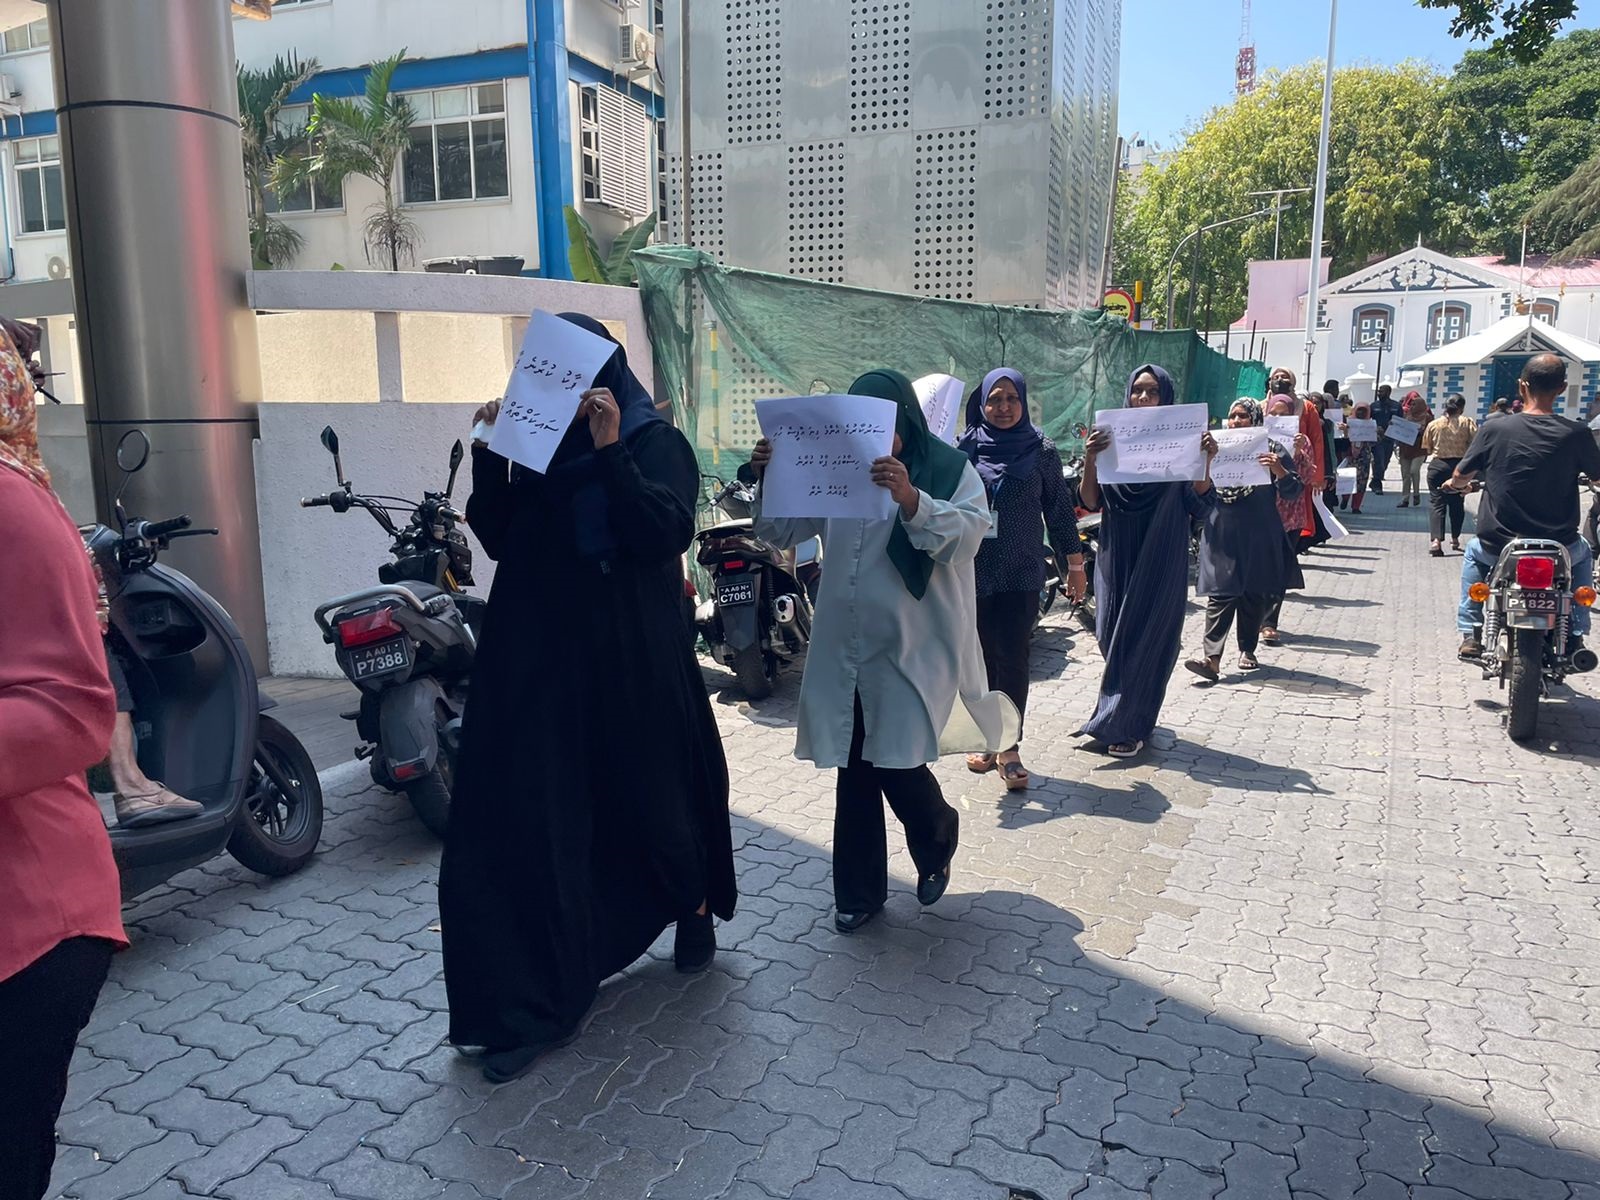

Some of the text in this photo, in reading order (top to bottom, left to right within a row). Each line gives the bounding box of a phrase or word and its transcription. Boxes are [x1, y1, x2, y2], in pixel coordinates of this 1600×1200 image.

[720, 591, 752, 603] C7061
[1509, 598, 1555, 609] P1822
[357, 652, 403, 675] P7388
